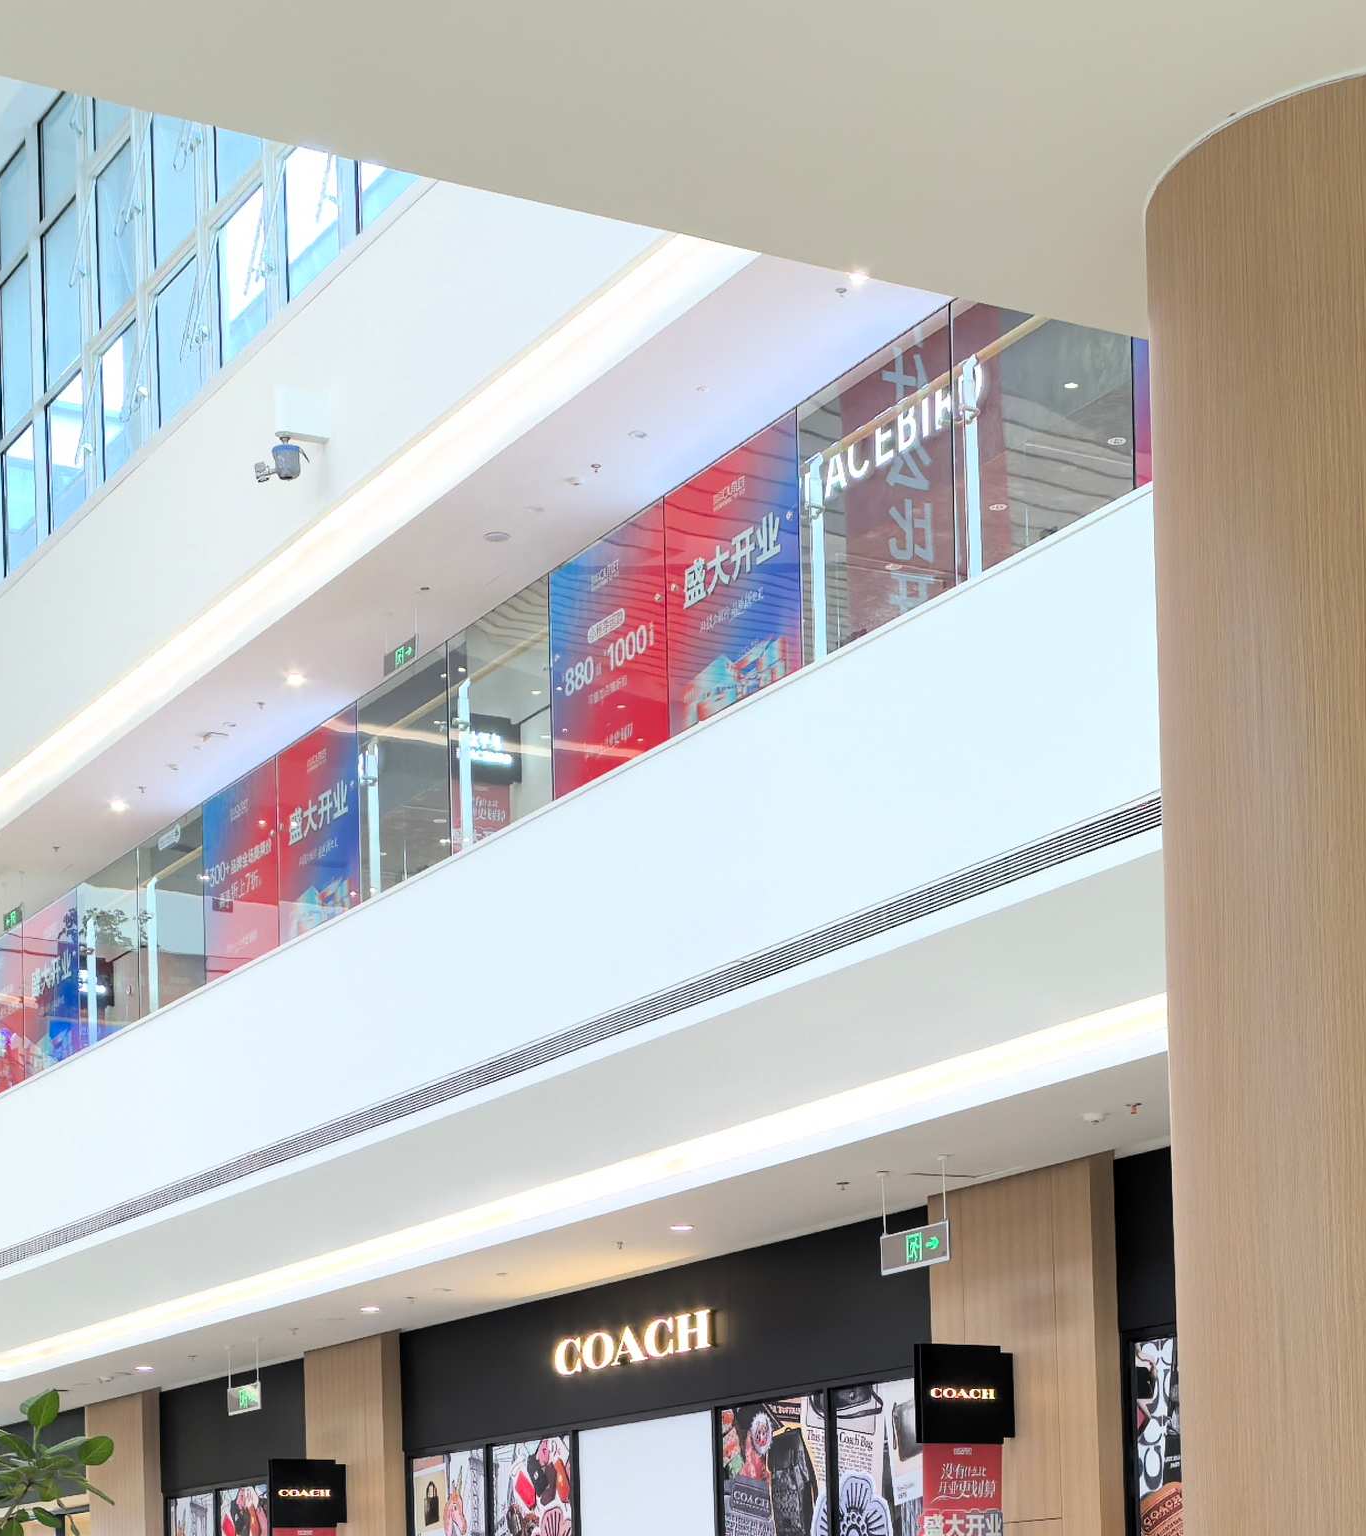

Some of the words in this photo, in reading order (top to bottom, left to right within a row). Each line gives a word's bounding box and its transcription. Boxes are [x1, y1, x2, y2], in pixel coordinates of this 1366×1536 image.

[682, 511, 782, 610] 盛大开业
[607, 624, 648, 672] 1000
[288, 779, 349, 846] 盛大开业
[554, 1308, 712, 1376] COACH
[930, 1387, 996, 1400] COACH
[839, 1430, 860, 1446] Coach
[860, 1436, 874, 1451] Bag
[277, 1488, 332, 1498] COACH
[733, 1490, 770, 1508] COACH
